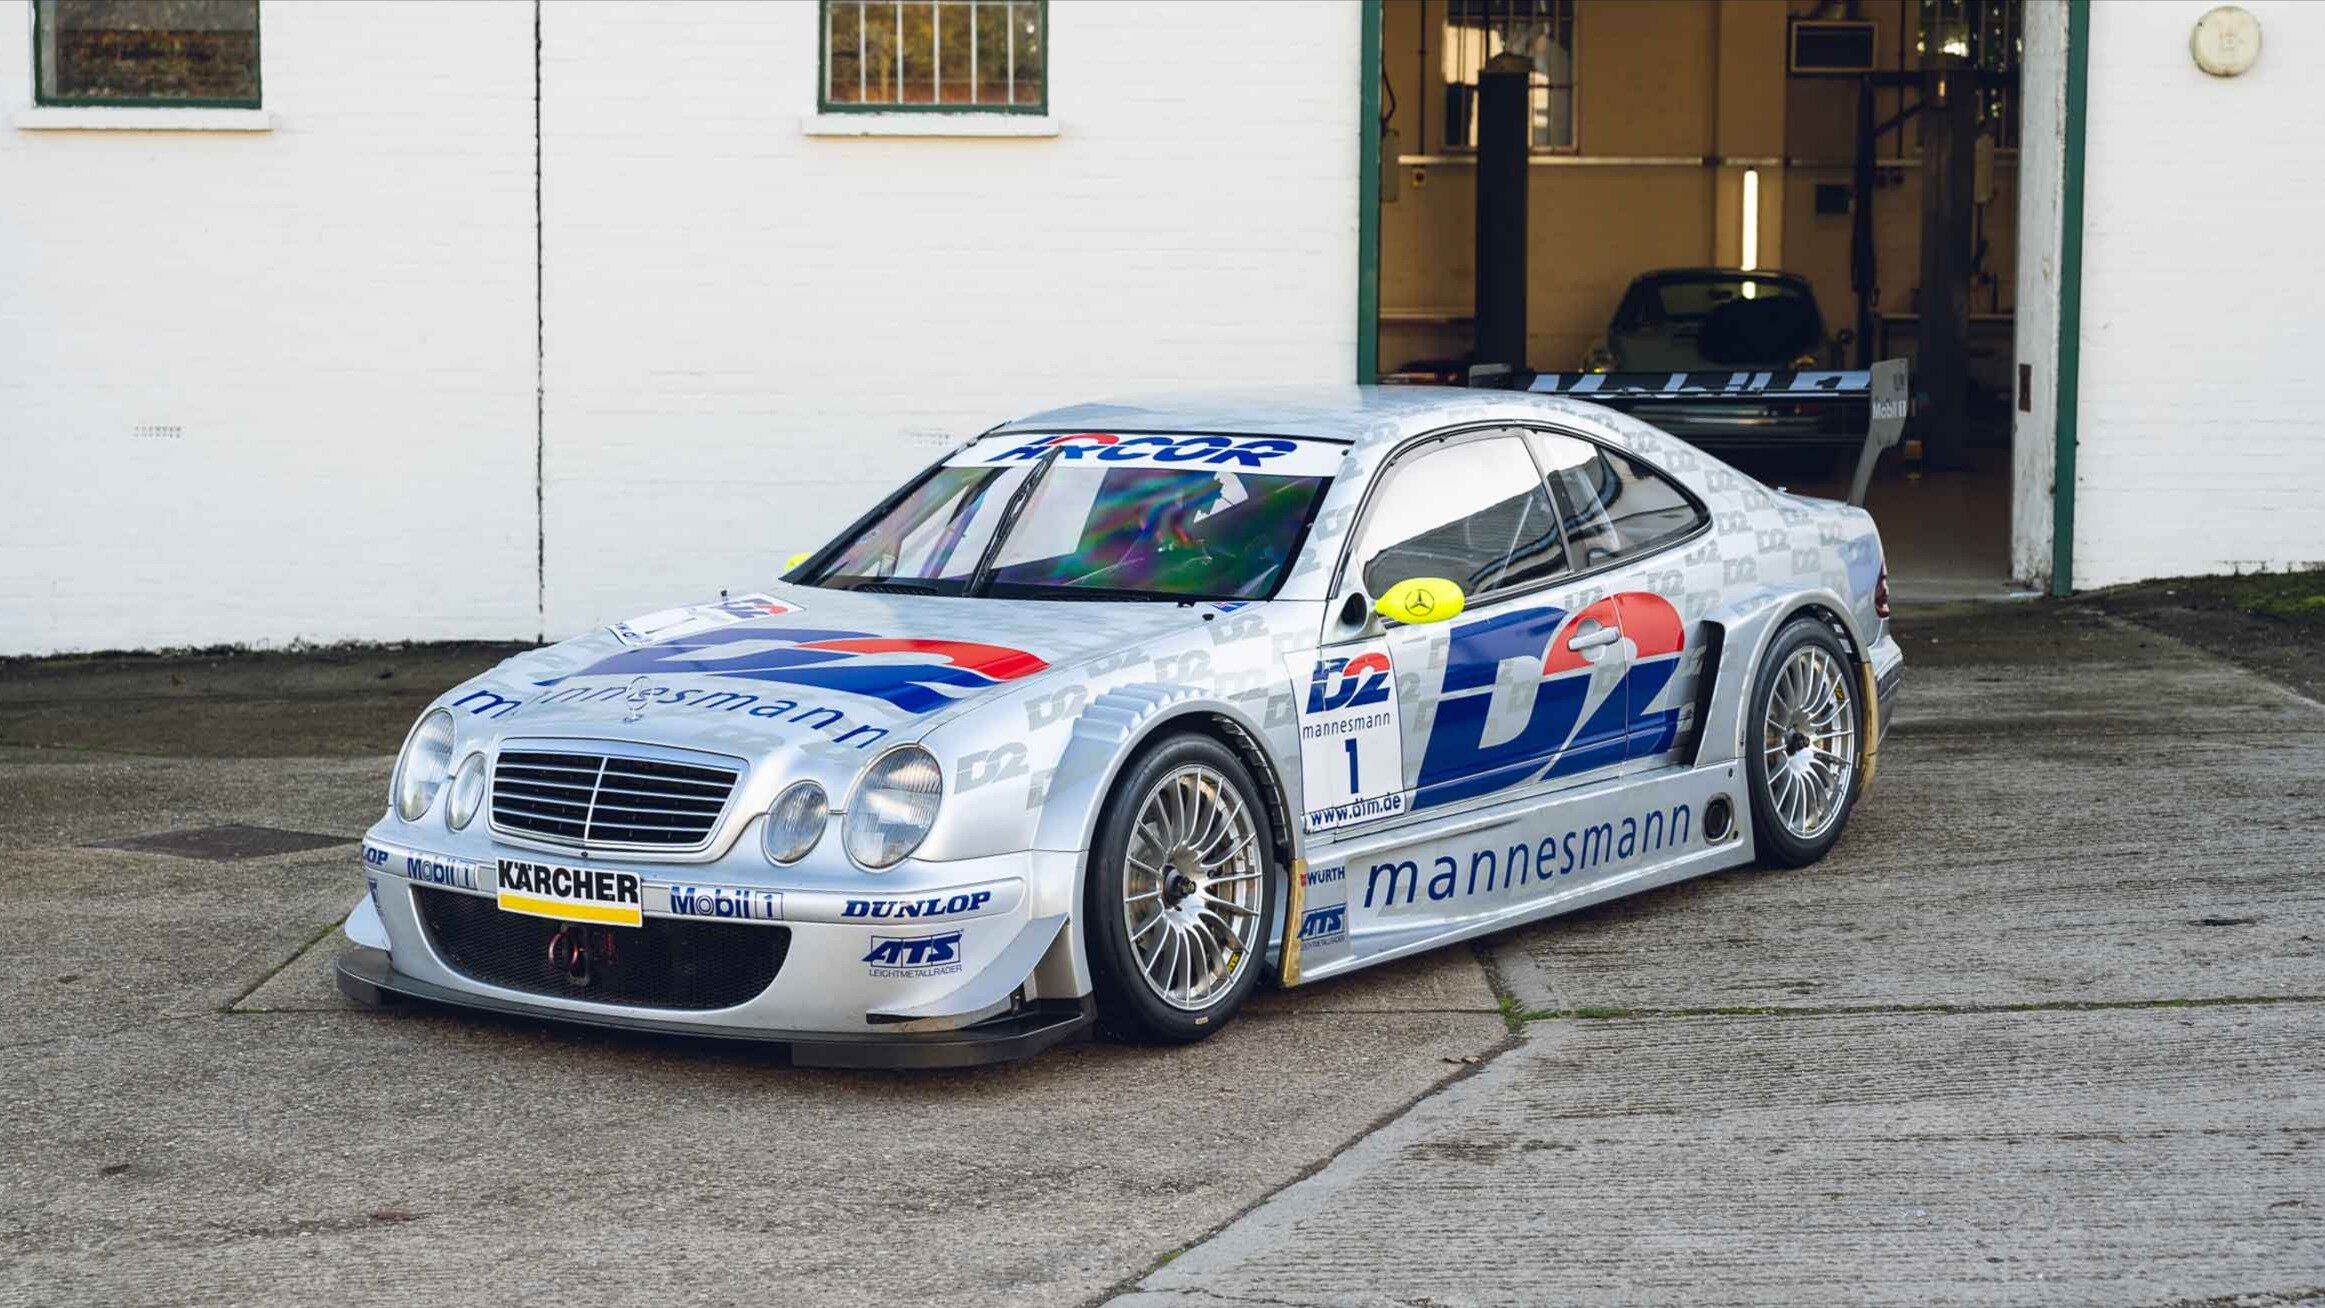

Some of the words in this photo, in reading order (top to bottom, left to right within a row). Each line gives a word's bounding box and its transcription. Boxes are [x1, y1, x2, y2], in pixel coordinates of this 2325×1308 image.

[534, 628, 1051, 713] D2
[1306, 652, 1390, 714] D2
[1411, 591, 1685, 811] D2
[1303, 712, 1390, 741] mannesmann
[954, 742, 1030, 794] D2
[1345, 738, 1359, 795] 1
[407, 857, 455, 886] Mobil
[1364, 803, 1691, 908] mannesmann
[499, 859, 639, 904] KÄRCHER
[670, 886, 750, 918] Mobil
[763, 894, 774, 918] 1
[841, 891, 991, 918] DUNLOP
[1297, 906, 1347, 939] ATS
[861, 934, 963, 964] ATS
